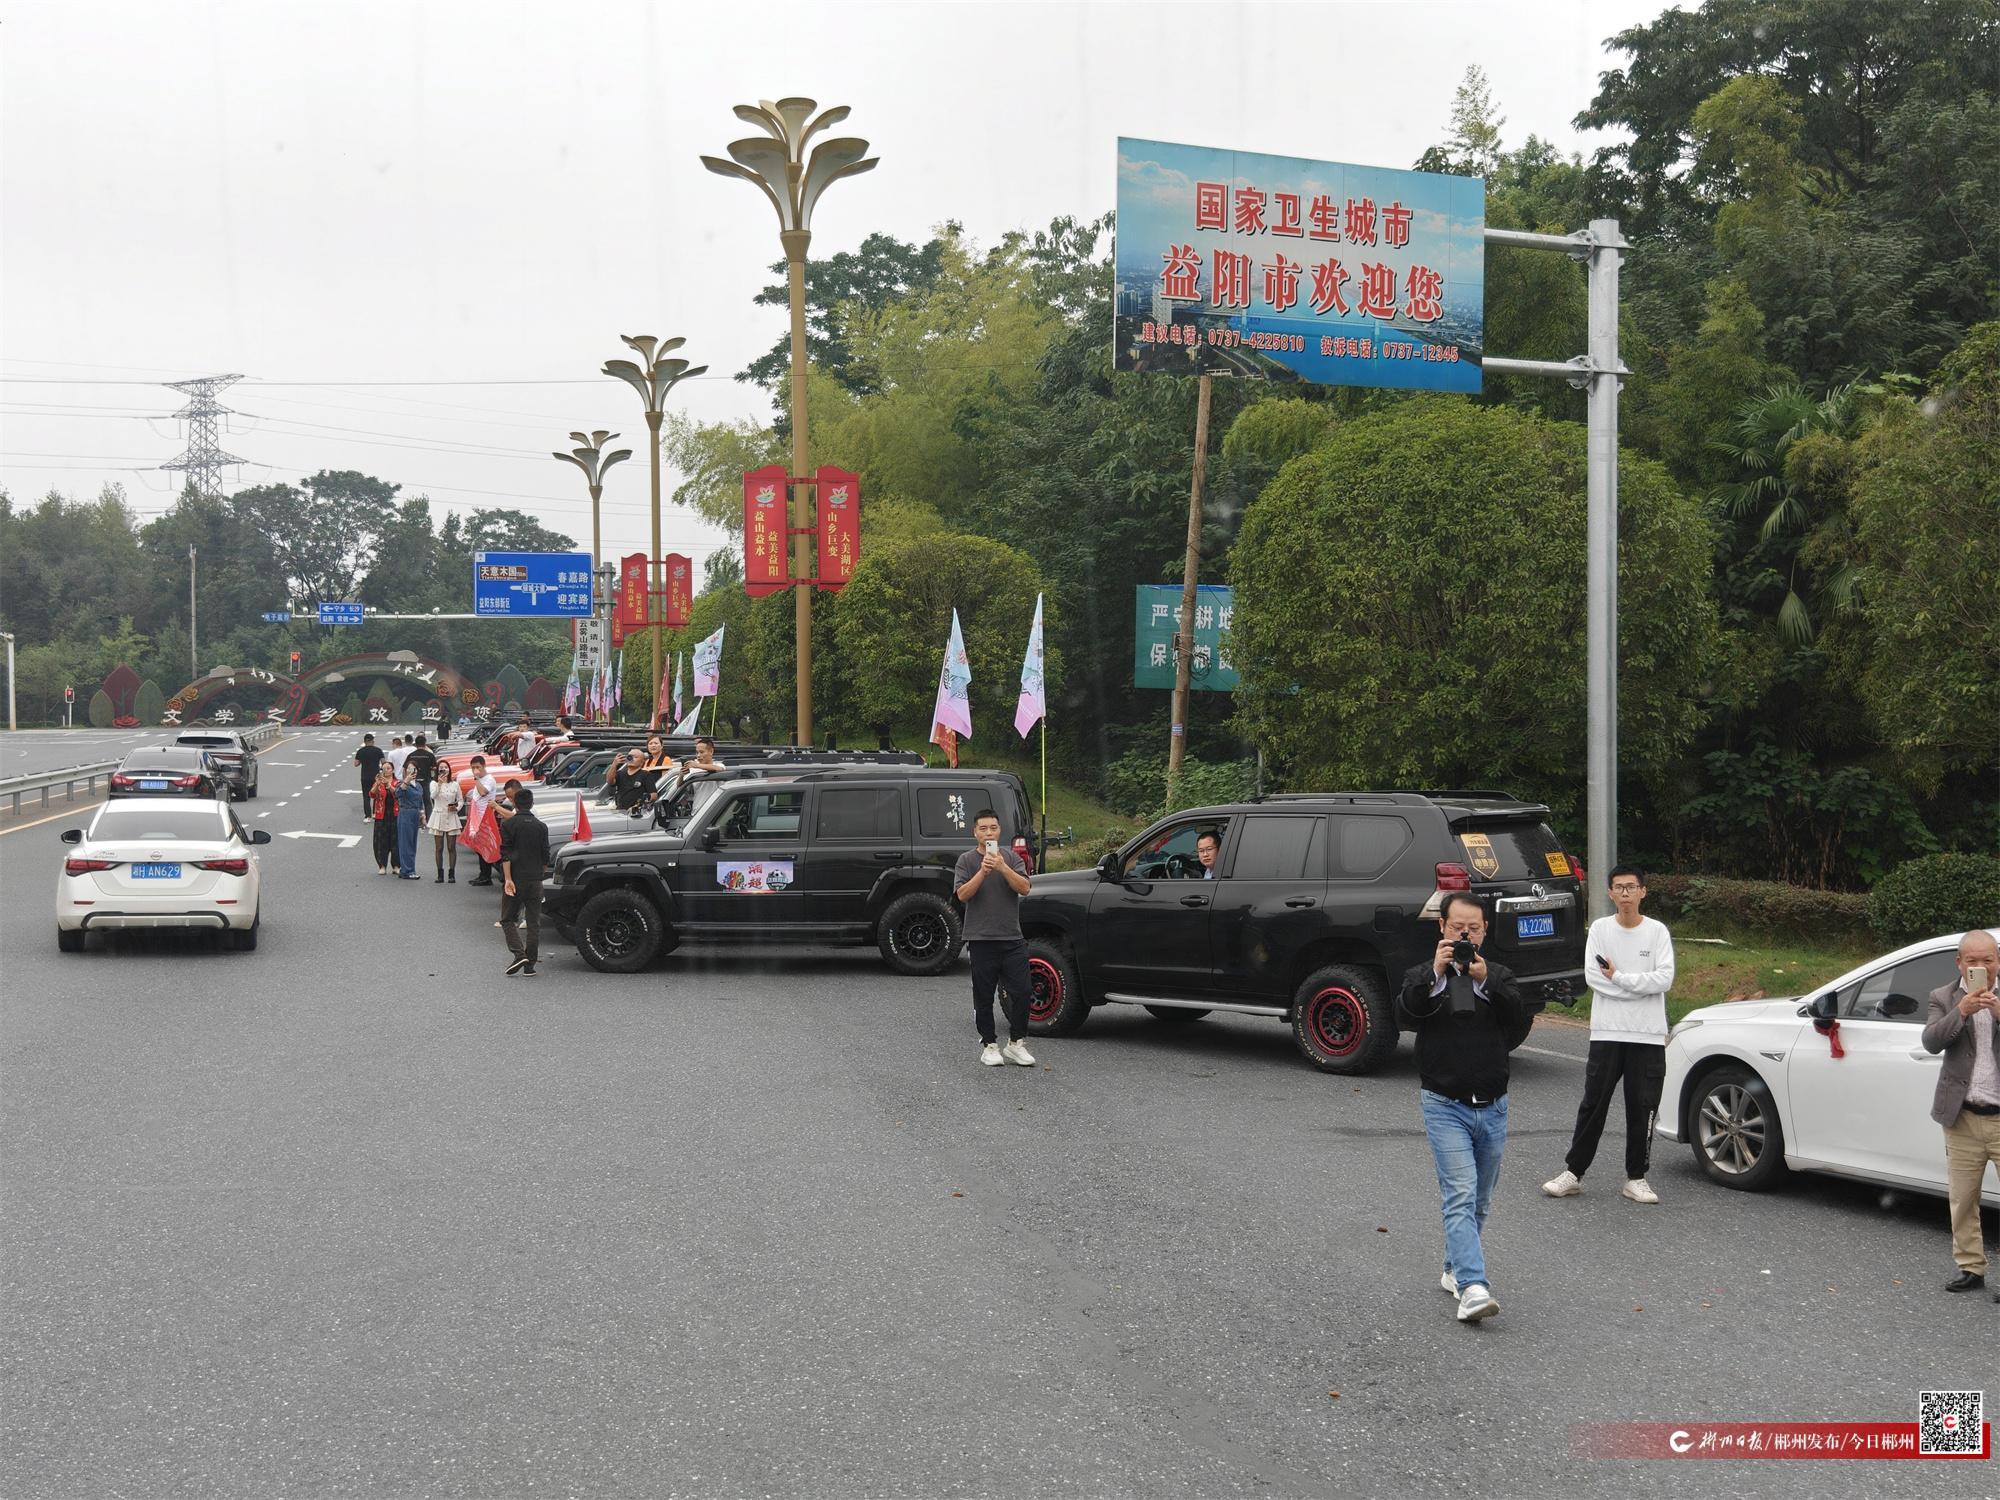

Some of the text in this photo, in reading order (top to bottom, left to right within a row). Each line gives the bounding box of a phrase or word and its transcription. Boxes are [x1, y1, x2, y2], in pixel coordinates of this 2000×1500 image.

[1195, 181, 1413, 248] 国家卫生城市
[1159, 244, 1443, 321] 益阳市欢迎您
[1383, 342, 1459, 363] 0737-12345
[755, 511, 765, 556] 益山益水
[768, 531, 778, 576] 益美益阳
[828, 512, 838, 557] 山乡巨变
[841, 531, 851, 576] 大美湖区
[557, 593, 588, 605] 迎宾路
[579, 620, 588, 667] 云雾山路施工
